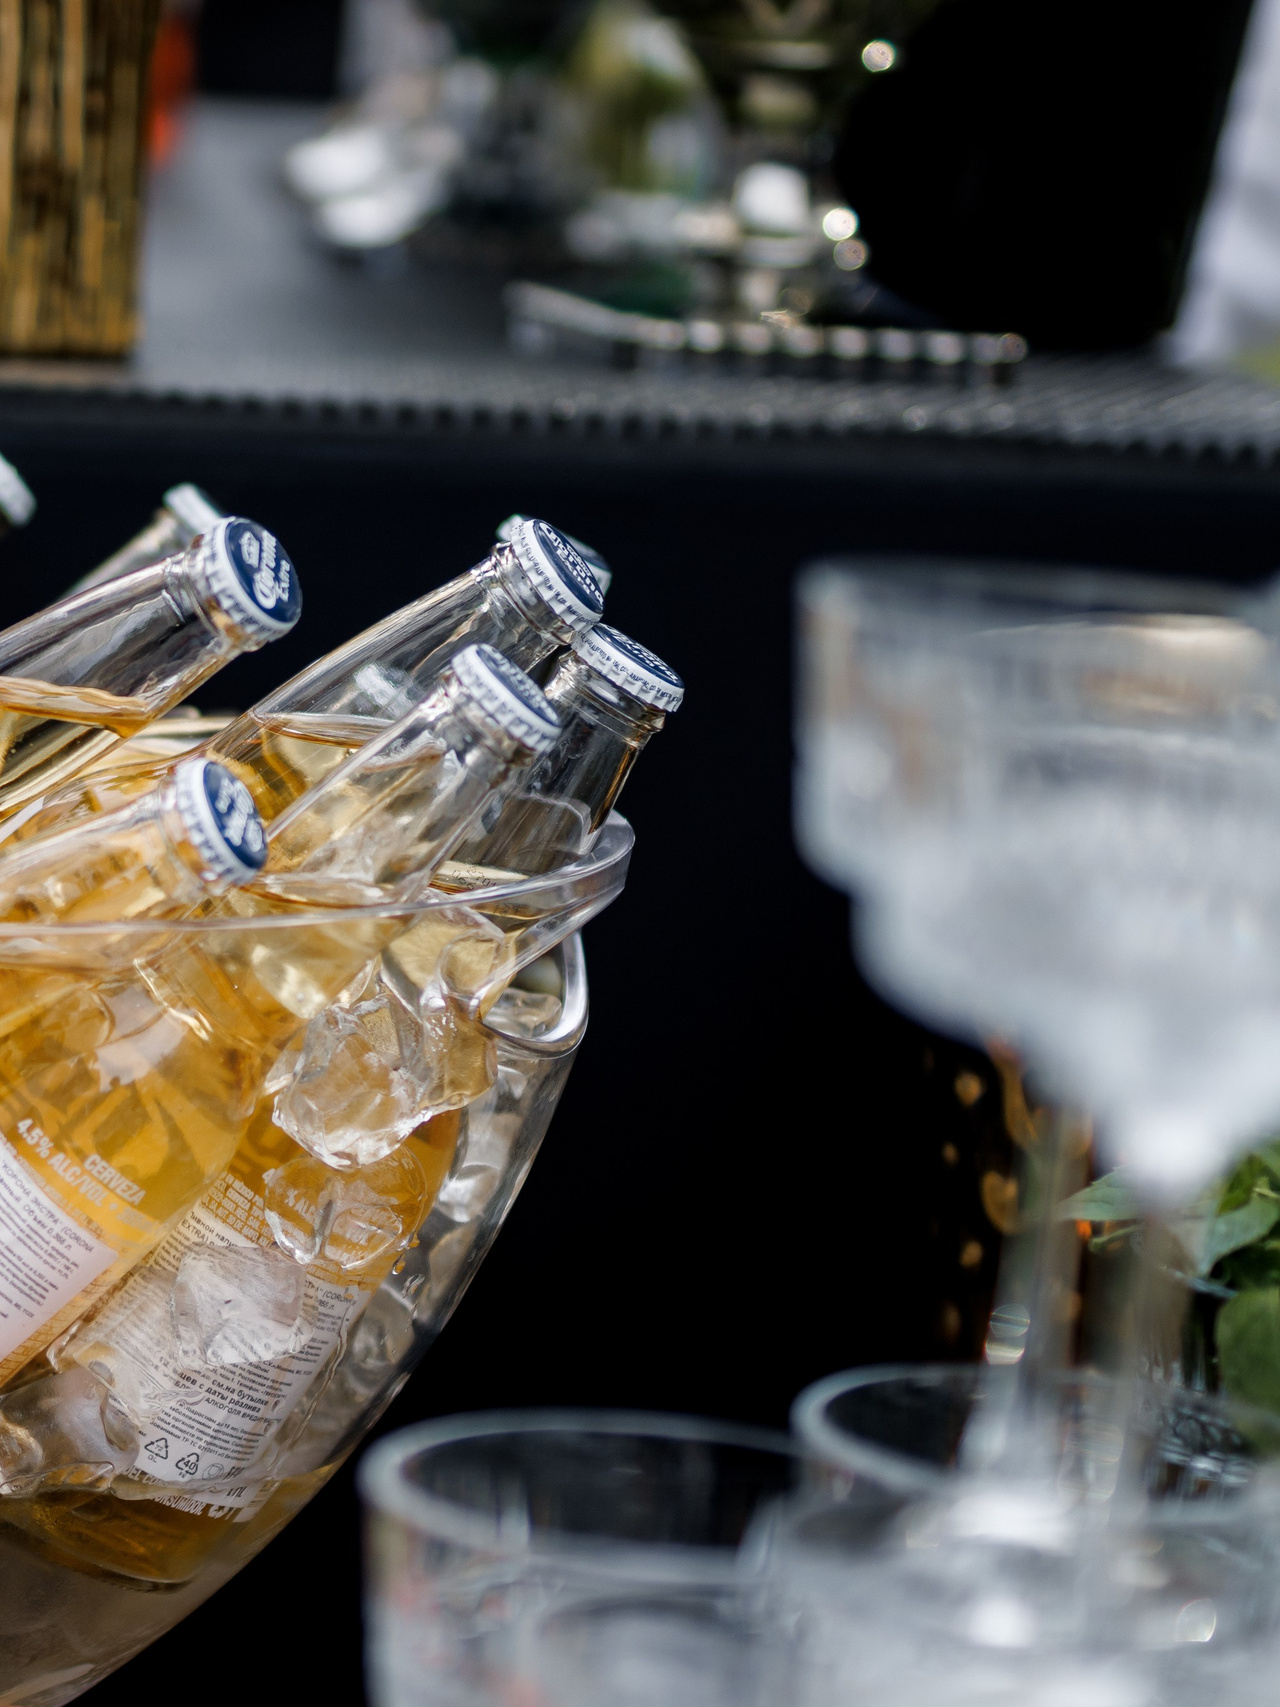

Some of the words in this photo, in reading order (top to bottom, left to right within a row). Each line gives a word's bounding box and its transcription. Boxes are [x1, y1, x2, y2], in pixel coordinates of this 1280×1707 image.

[538, 521, 605, 605] Corona
[556, 547, 591, 596] Extra
[17, 1118, 54, 1159] 4.5%
[47, 1152, 110, 1207] ALC/VOL
[84, 1153, 146, 1205] CERVEZA
[0, 1159, 32, 1197] "КОРОНА
[31, 1196, 62, 1227] ЭКСТРА"
[61, 1225, 94, 1252] (CORONA
[22, 1203, 48, 1230] Объем
[181, 1218, 209, 1242] EXTRA)
[214, 1231, 239, 1249] напи
[204, 1395, 241, 1417] АЛКОГОЛЯ
[205, 1386, 228, 1402] даты
[228, 1397, 261, 1414] розлива
[211, 1378, 236, 1394] см.на
[236, 1389, 269, 1407] бутылке
[181, 1458, 196, 1469] 40
